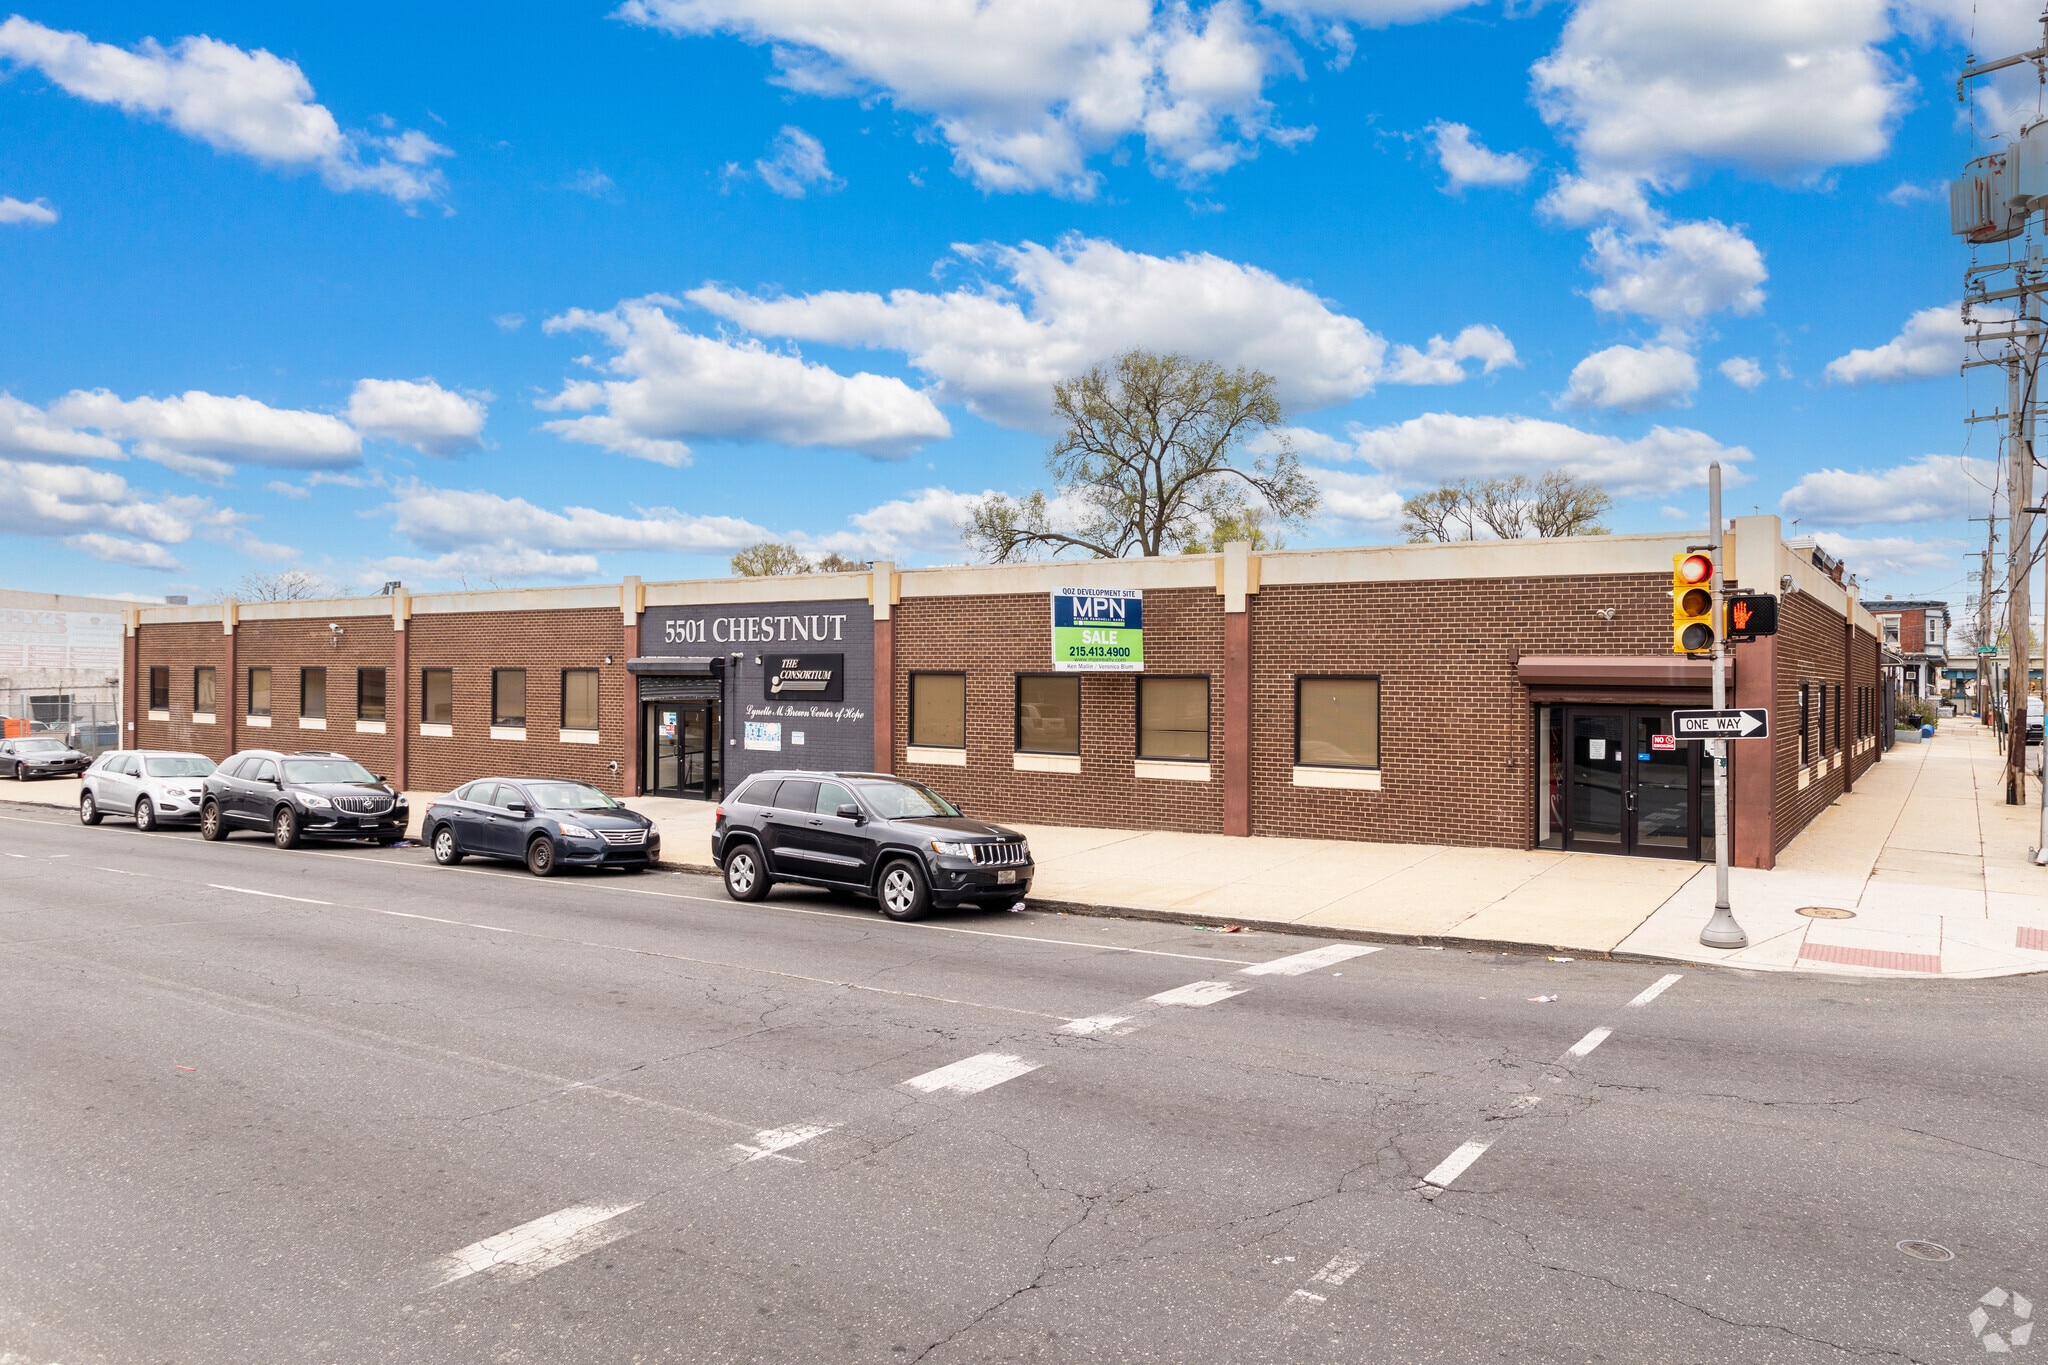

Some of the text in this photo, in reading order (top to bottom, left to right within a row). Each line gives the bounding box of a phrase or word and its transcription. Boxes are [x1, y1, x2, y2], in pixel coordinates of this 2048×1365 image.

[1062, 587, 1136, 598] QOZ DEVELOPMENT SITE
[1073, 597, 1125, 618] MPN
[0, 610, 67, 625] HY'S
[664, 614, 847, 643] 5501 CHESTNUT
[1082, 630, 1118, 645] SALE
[1069, 646, 1130, 657] 215.413.4900
[781, 659, 799, 668] THE
[780, 670, 832, 680] CONSORTIUM
[784, 706, 810, 717] Brown
[810, 706, 834, 718] Center
[834, 708, 845, 722] of
[843, 708, 865, 722] Hope
[1686, 718, 1741, 730] ONE WAY
[1654, 736, 1664, 744] NO
